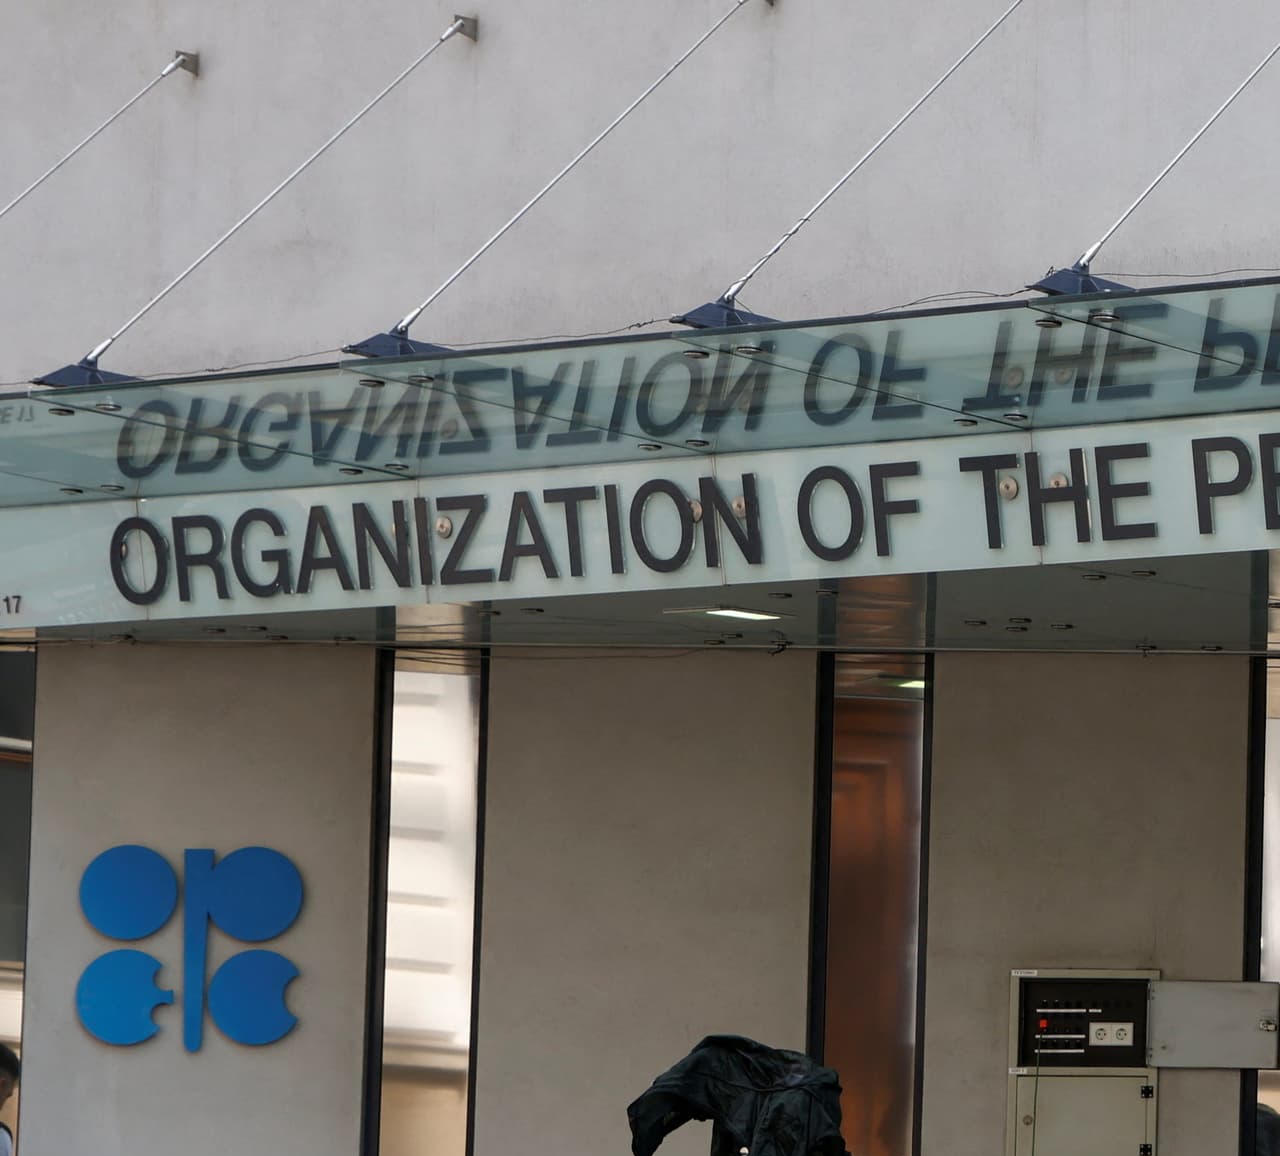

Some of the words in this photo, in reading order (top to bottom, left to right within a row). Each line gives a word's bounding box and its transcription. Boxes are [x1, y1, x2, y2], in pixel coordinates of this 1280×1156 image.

[110, 472, 763, 606] ORGANIZATION
[797, 460, 921, 562] OF
[959, 442, 1159, 551] THE
[3, 595, 22, 614] 17
